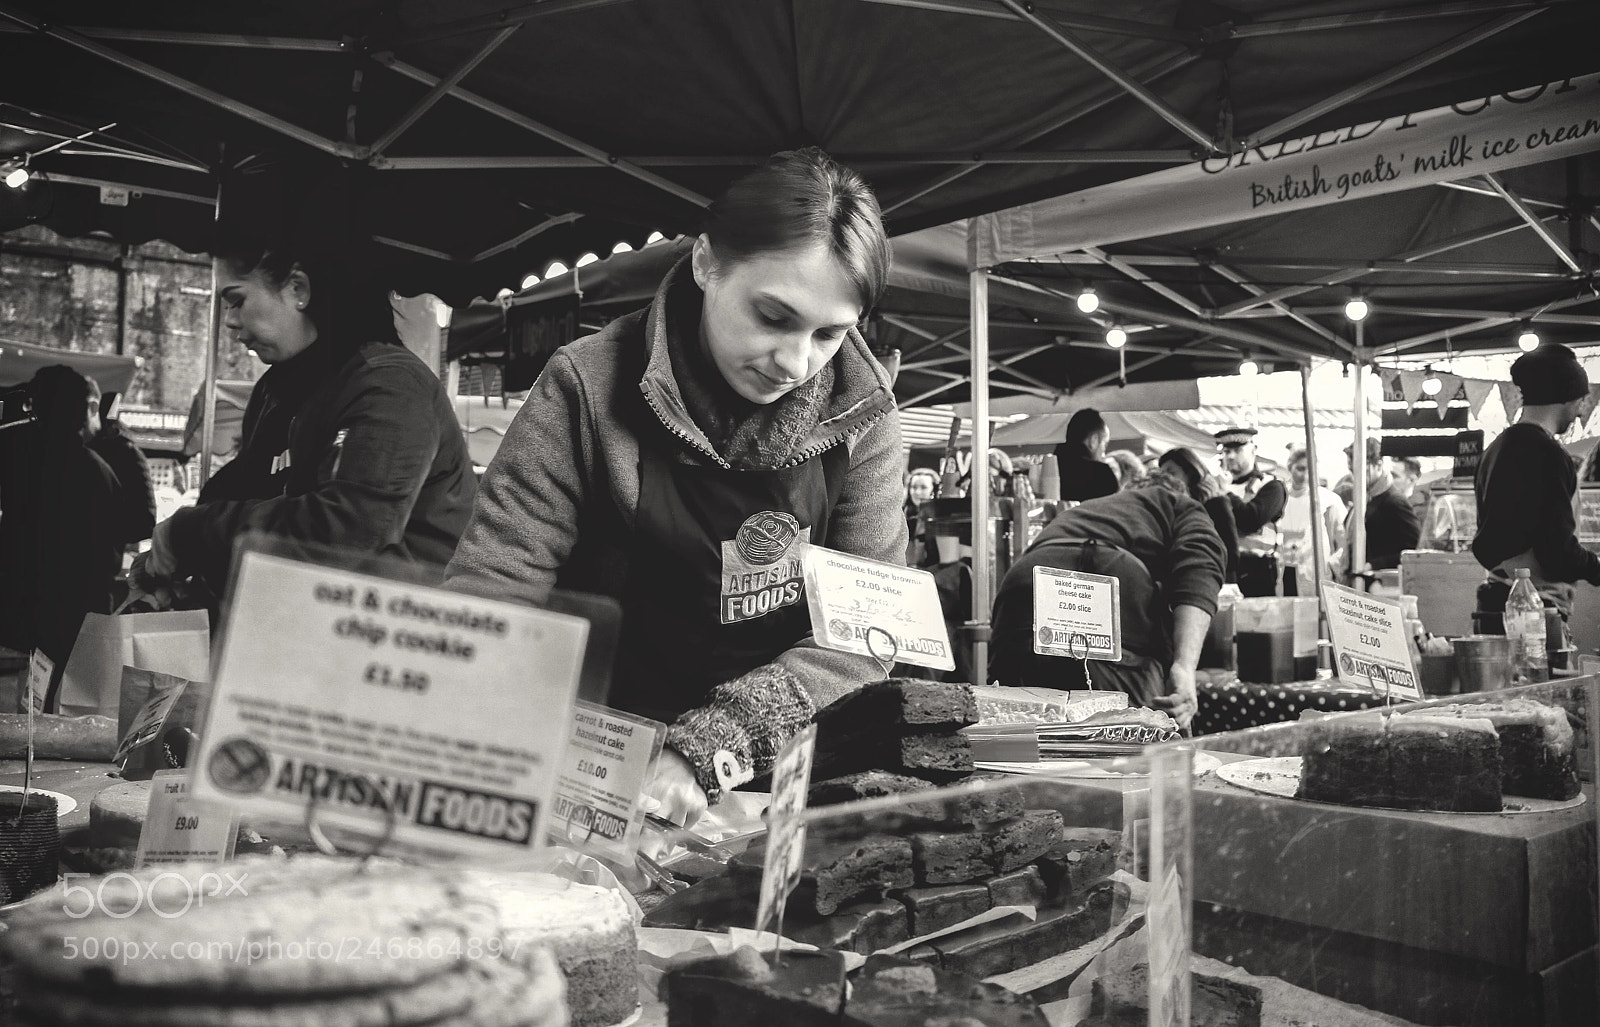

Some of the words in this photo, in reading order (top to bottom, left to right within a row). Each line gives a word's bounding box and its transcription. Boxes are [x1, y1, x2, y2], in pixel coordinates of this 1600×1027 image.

[1251, 165, 1331, 208] British
[1337, 154, 1406, 199] goats'
[1414, 134, 1473, 174] milk
[1482, 138, 1520, 159] ice
[728, 560, 802, 594] ARTISAN
[827, 560, 866, 574] chocolate
[867, 568, 889, 580] fudge
[855, 579, 880, 591] £2.00
[882, 586, 902, 597] slice
[1055, 579, 1072, 588] baked
[1073, 582, 1094, 591] german
[1058, 589, 1077, 597] cheese
[313, 582, 355, 609] oat
[362, 588, 380, 611] &
[387, 594, 509, 637] chocolate
[727, 581, 799, 621] FOODS
[1059, 601, 1076, 611] £2.00
[1077, 604, 1092, 613] slice
[1364, 604, 1386, 615] roasted
[1364, 614, 1378, 624] cake
[333, 614, 387, 647] chip
[393, 630, 477, 662] cookie
[905, 639, 944, 657] FOODS
[1087, 635, 1110, 648] FOODS
[1360, 633, 1381, 648] £2.00
[1387, 667, 1414, 688] FOODS
[575, 712, 597, 727] carrot
[598, 717, 604, 728] &
[605, 719, 634, 737] roasted
[575, 726, 607, 745] hazelnut
[607, 737, 625, 751] cake
[577, 759, 607, 779] £10.00
[275, 759, 413, 818] ARTISAN
[421, 786, 531, 844] FOODS
[175, 816, 199, 830] £9.00
[593, 810, 625, 840] FOODS
